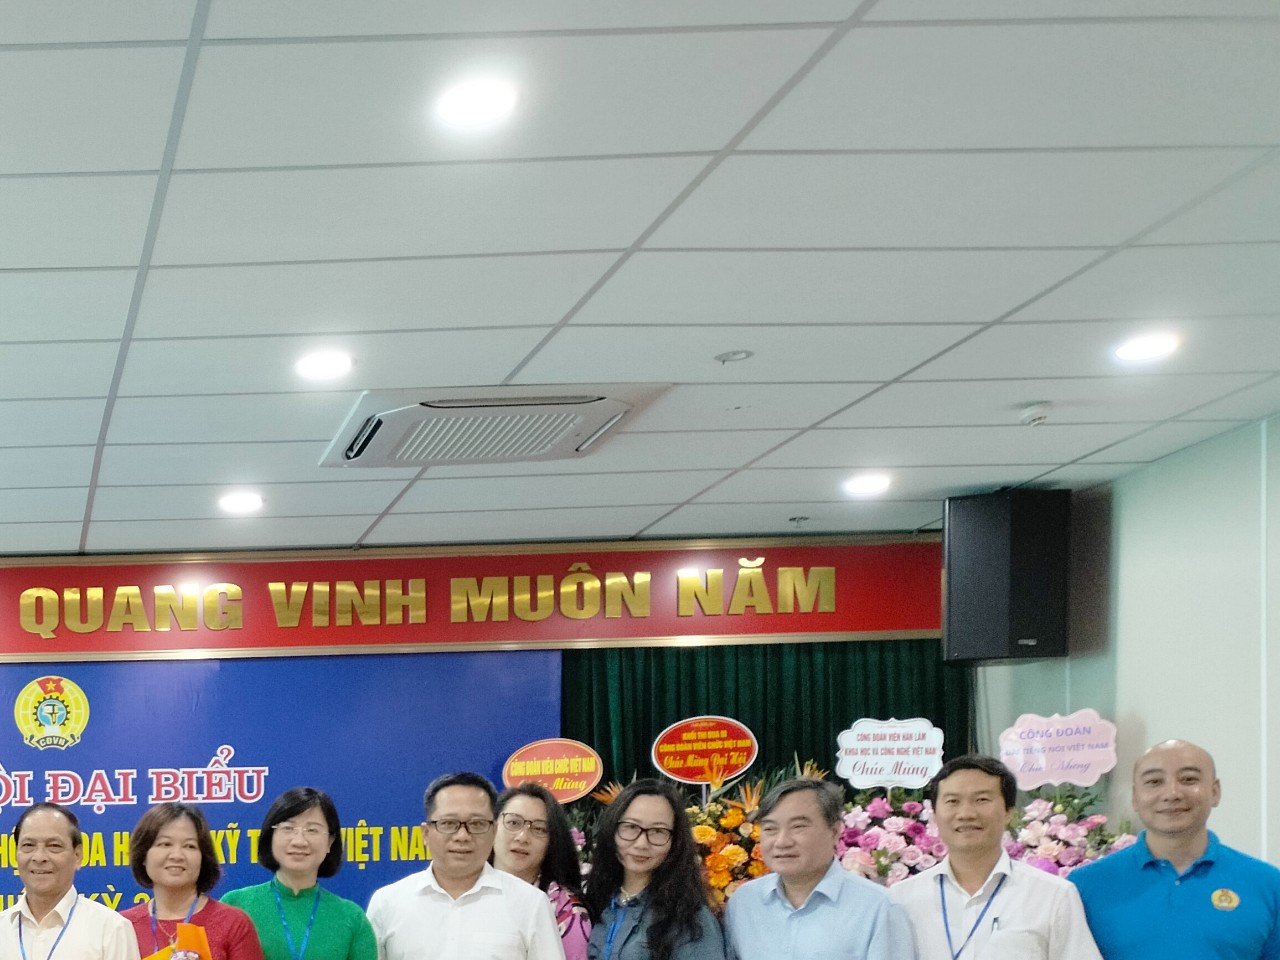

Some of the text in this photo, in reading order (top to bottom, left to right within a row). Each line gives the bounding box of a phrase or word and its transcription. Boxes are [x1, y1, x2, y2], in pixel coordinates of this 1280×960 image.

[19, 581, 245, 641] QUANG
[268, 578, 427, 629] VINH
[450, 562, 651, 623] MUÔN
[676, 556, 837, 617] NĂM
[39, 736, 66, 747] CĐVN
[1019, 725, 1093, 741] CÔNG ĐOÀN
[510, 758, 526, 777] CÔNG
[582, 756, 596, 774] NAM
[852, 760, 929, 778] Chúc Mừng
[45, 768, 143, 815] ĐẠI
[148, 744, 270, 805] BIỂU
[551, 777, 587, 792] Mừng
[390, 826, 433, 862] NA
